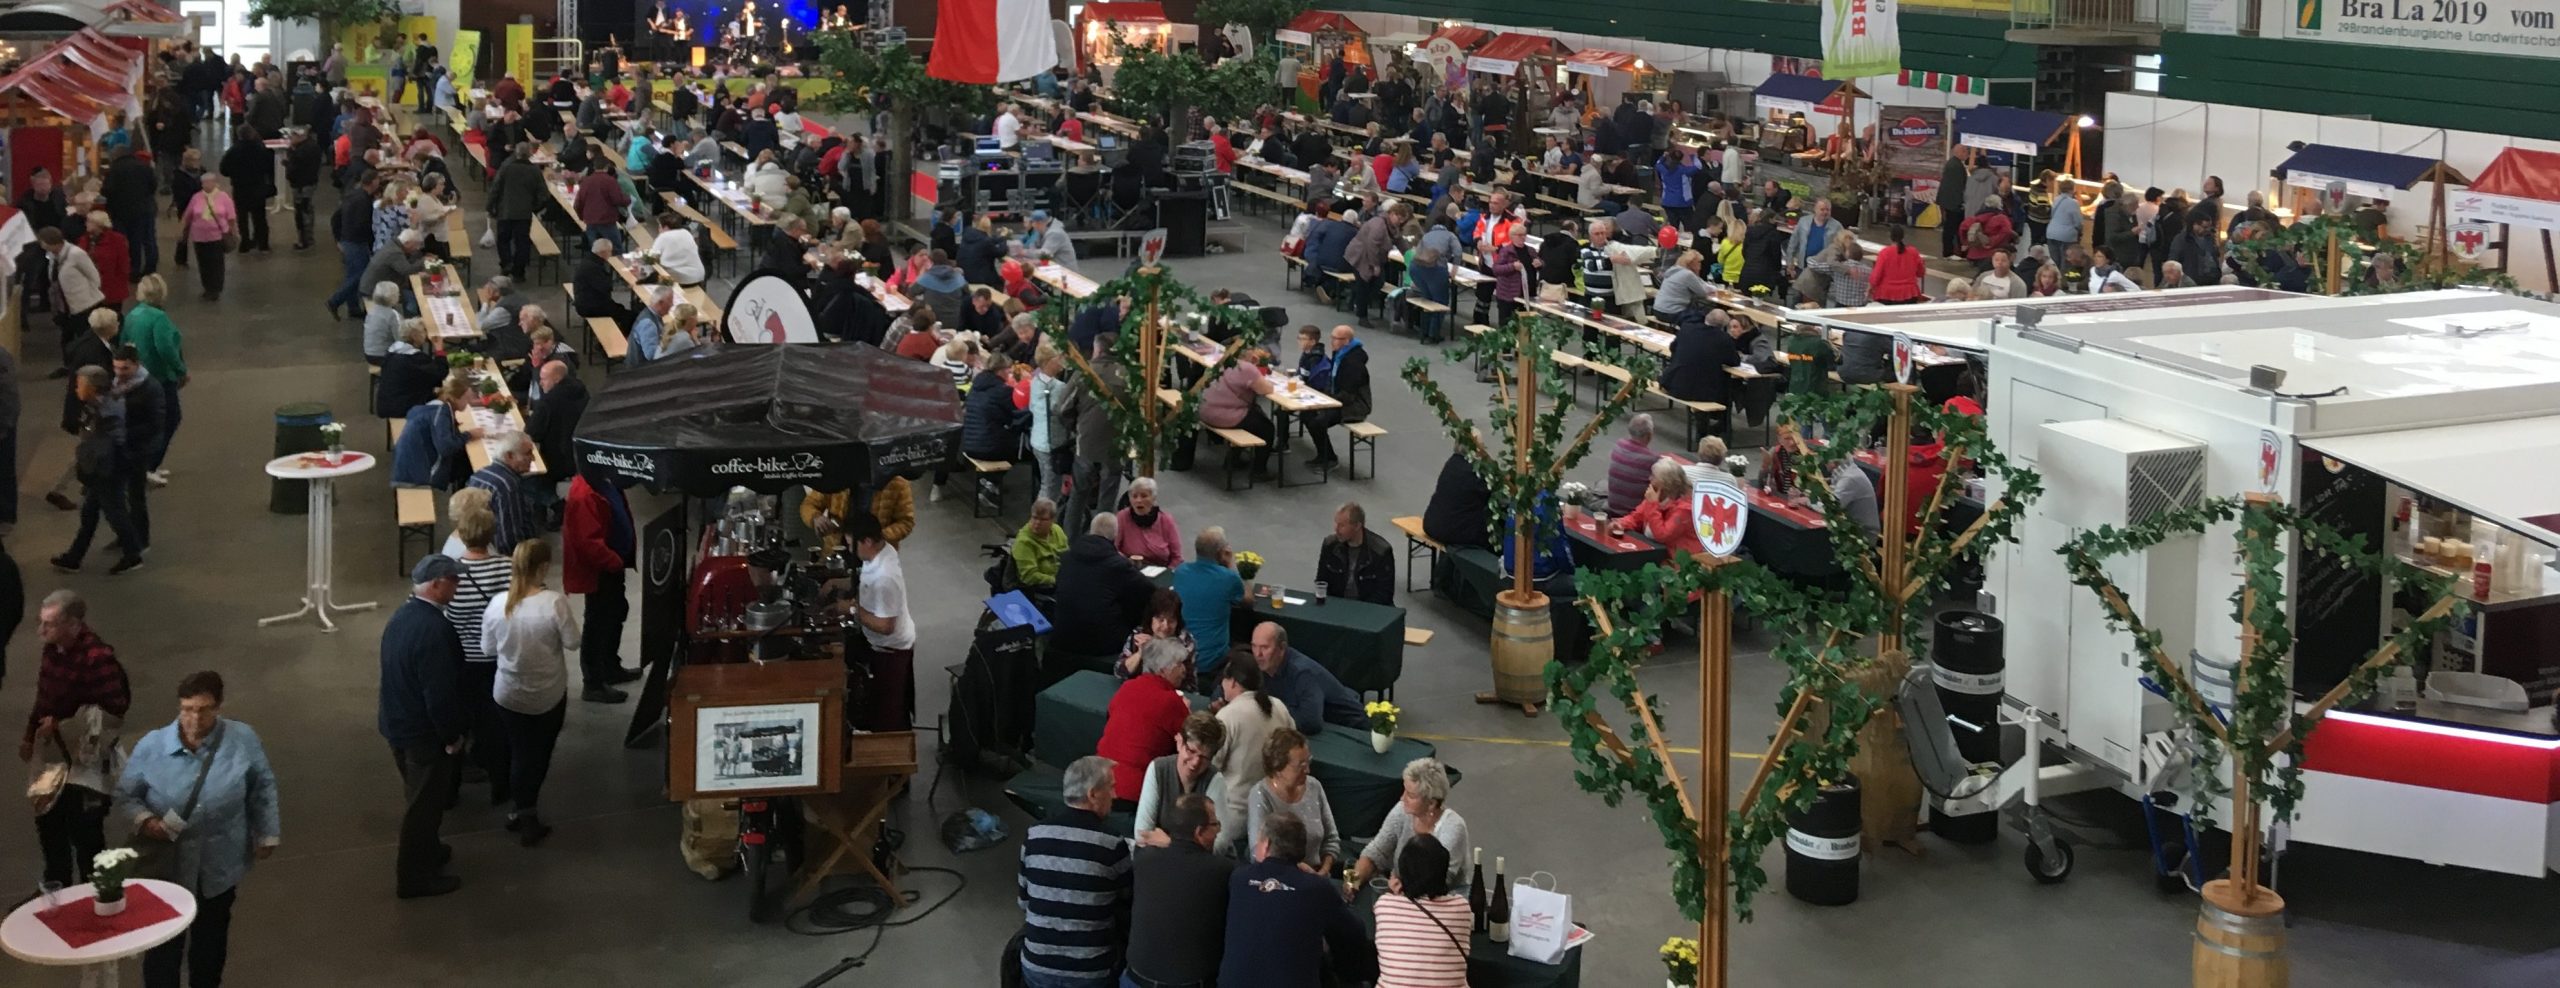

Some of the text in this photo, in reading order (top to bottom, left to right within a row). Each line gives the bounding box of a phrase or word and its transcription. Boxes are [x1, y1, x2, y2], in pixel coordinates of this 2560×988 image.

[2341, 0, 2554, 29] Bra La 2019 vom
[711, 457, 788, 474] coffee-bike
